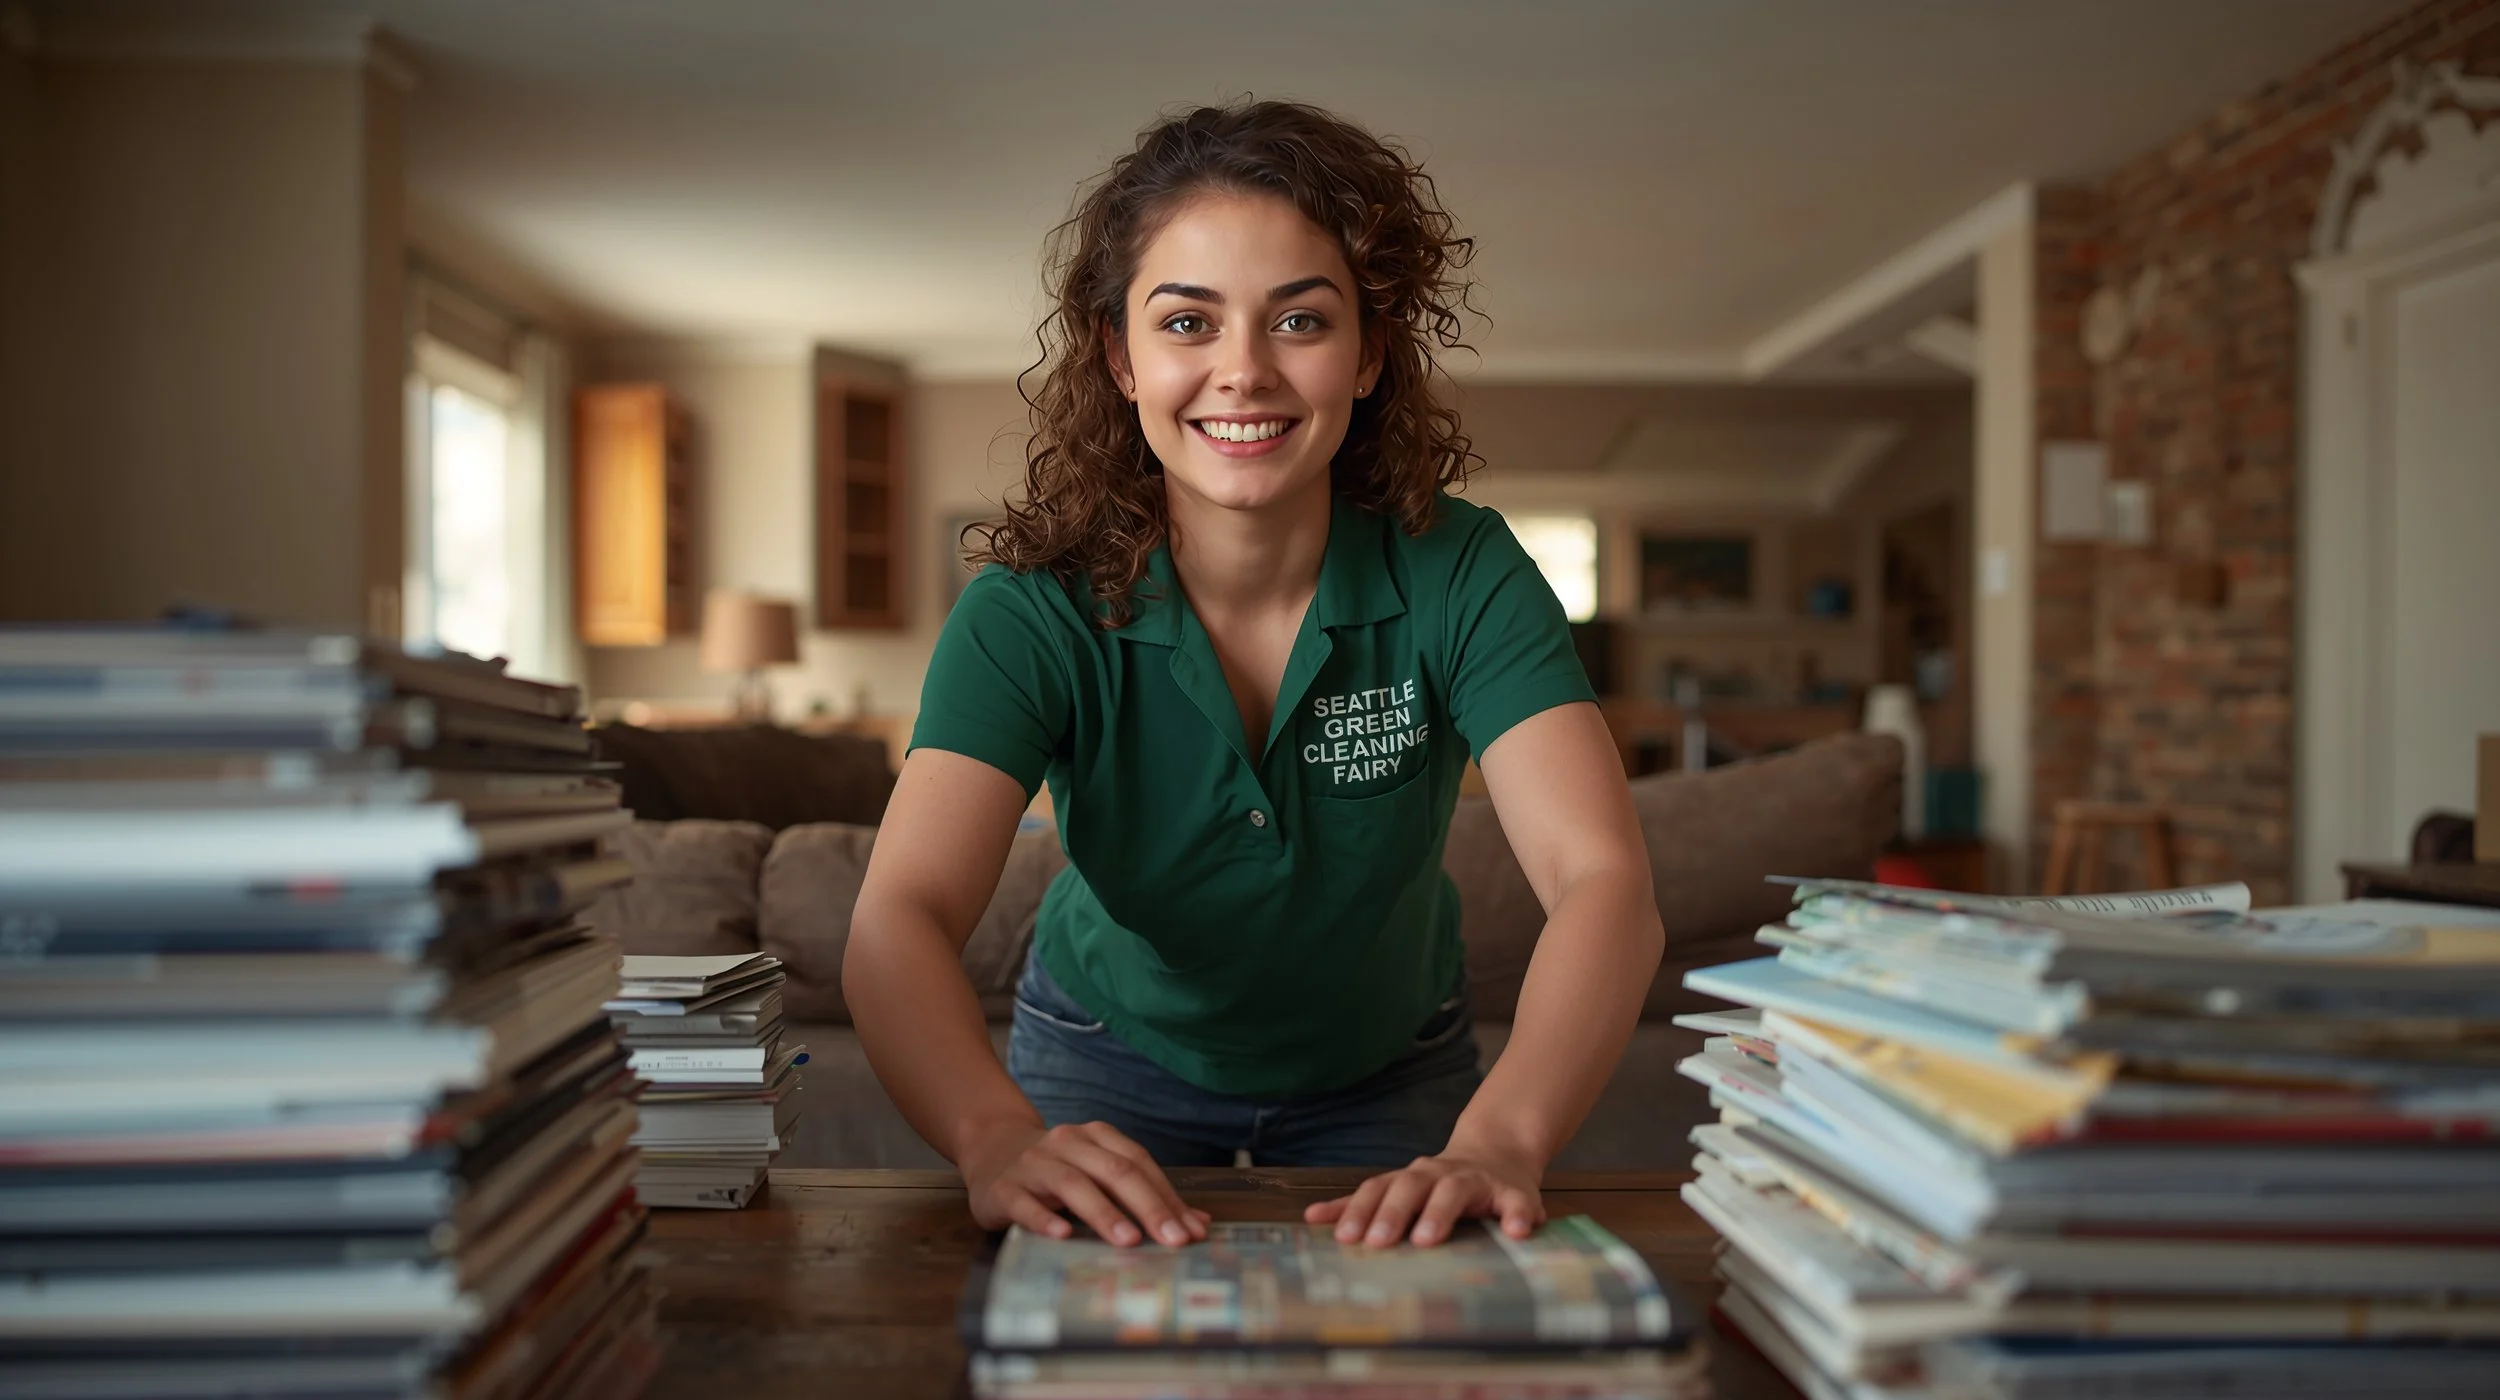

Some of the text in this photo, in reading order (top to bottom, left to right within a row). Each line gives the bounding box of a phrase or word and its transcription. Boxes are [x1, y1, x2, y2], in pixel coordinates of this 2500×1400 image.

[1313, 678, 1416, 718] SEATTLE
[1324, 706, 1411, 739] GREEN
[1303, 723, 1429, 764] CLEANING
[1333, 754, 1402, 785] FAIRY
